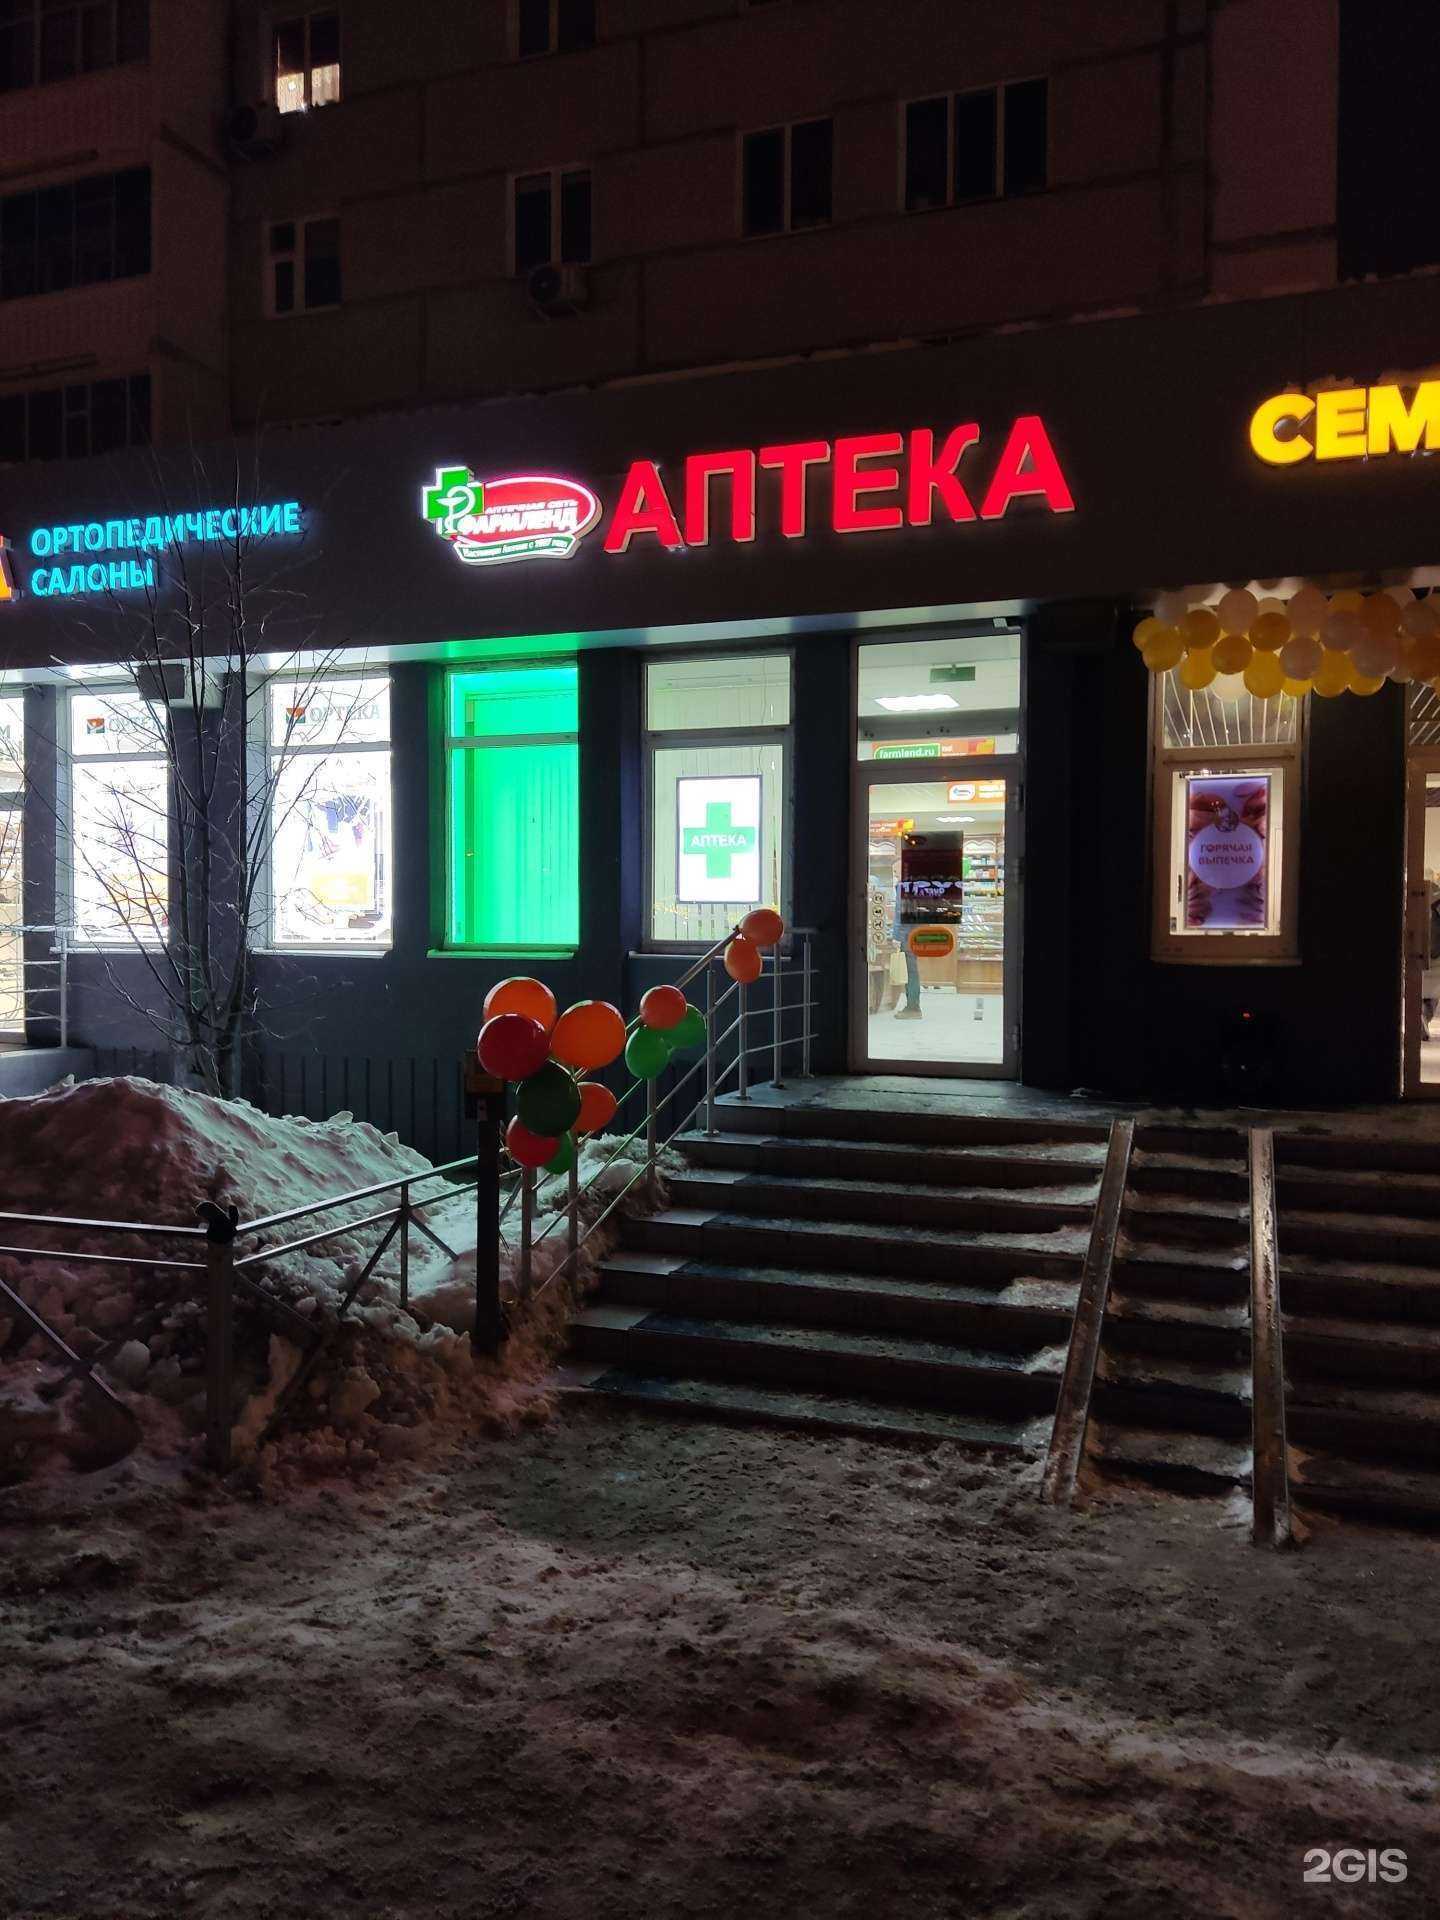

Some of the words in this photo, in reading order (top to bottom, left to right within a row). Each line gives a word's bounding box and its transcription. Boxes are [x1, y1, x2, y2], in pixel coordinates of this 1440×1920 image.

[603, 416, 1076, 554] АПТЕКА
[31, 502, 300, 556] ОРТОПЕДИЧЕСКИЕ
[31, 558, 154, 597] САЛОНЫ
[879, 746, 935, 759] farmland.ru
[690, 834, 748, 849] АПТЕКА
[1200, 843, 1253, 853] ГОРЯЧАЯ
[1198, 855, 1255, 866] ВЫПЕЧКА
